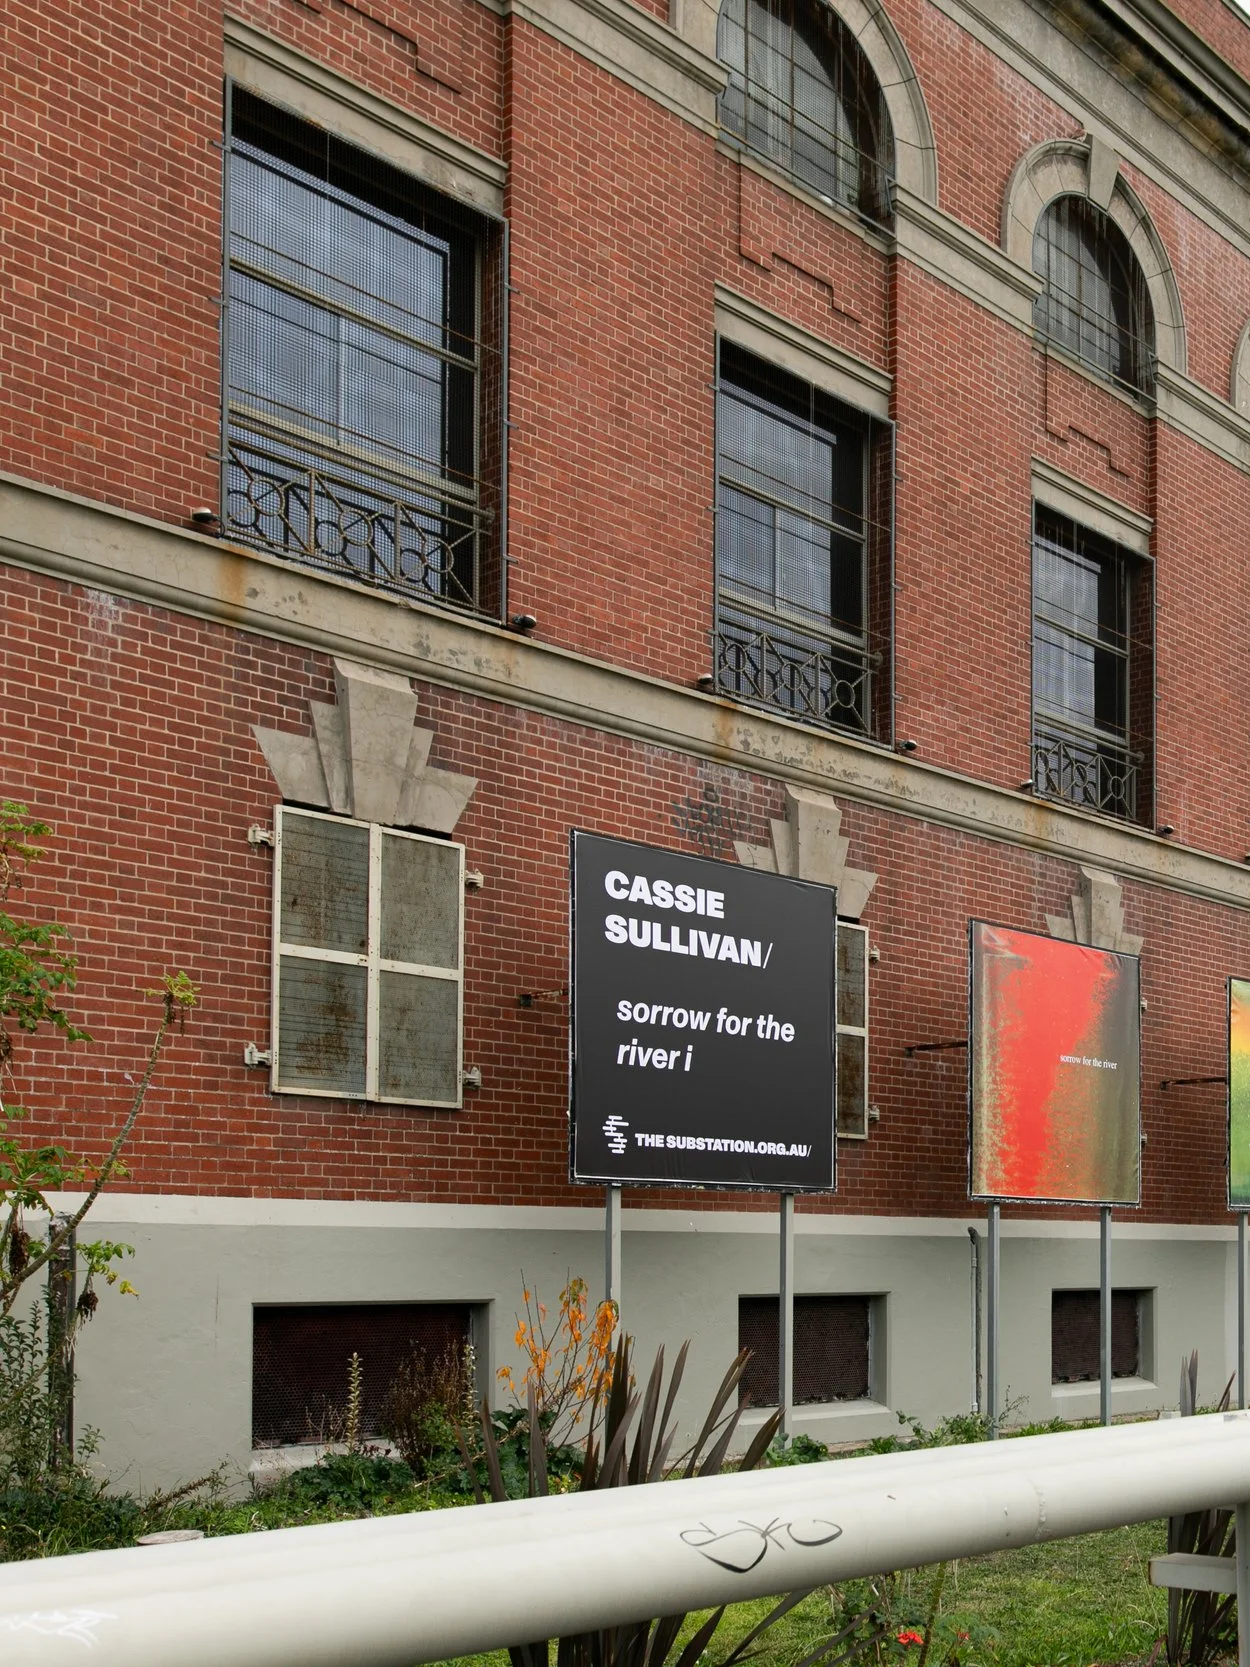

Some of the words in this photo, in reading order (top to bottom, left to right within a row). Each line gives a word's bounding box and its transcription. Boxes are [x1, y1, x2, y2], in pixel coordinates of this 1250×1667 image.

[604, 870, 725, 919] CASSIE
[604, 914, 774, 969] SULLIVAN/
[616, 1000, 711, 1031] sorrow
[716, 1007, 752, 1036] for
[757, 1014, 795, 1042] the
[616, 1038, 681, 1070] river
[684, 1045, 693, 1071] i
[1060, 1054, 1081, 1064] sorrow
[1082, 1055, 1092, 1066] for
[1092, 1057, 1102, 1068] the
[1103, 1059, 1118, 1070] river
[635, 1133, 664, 1149] THE
